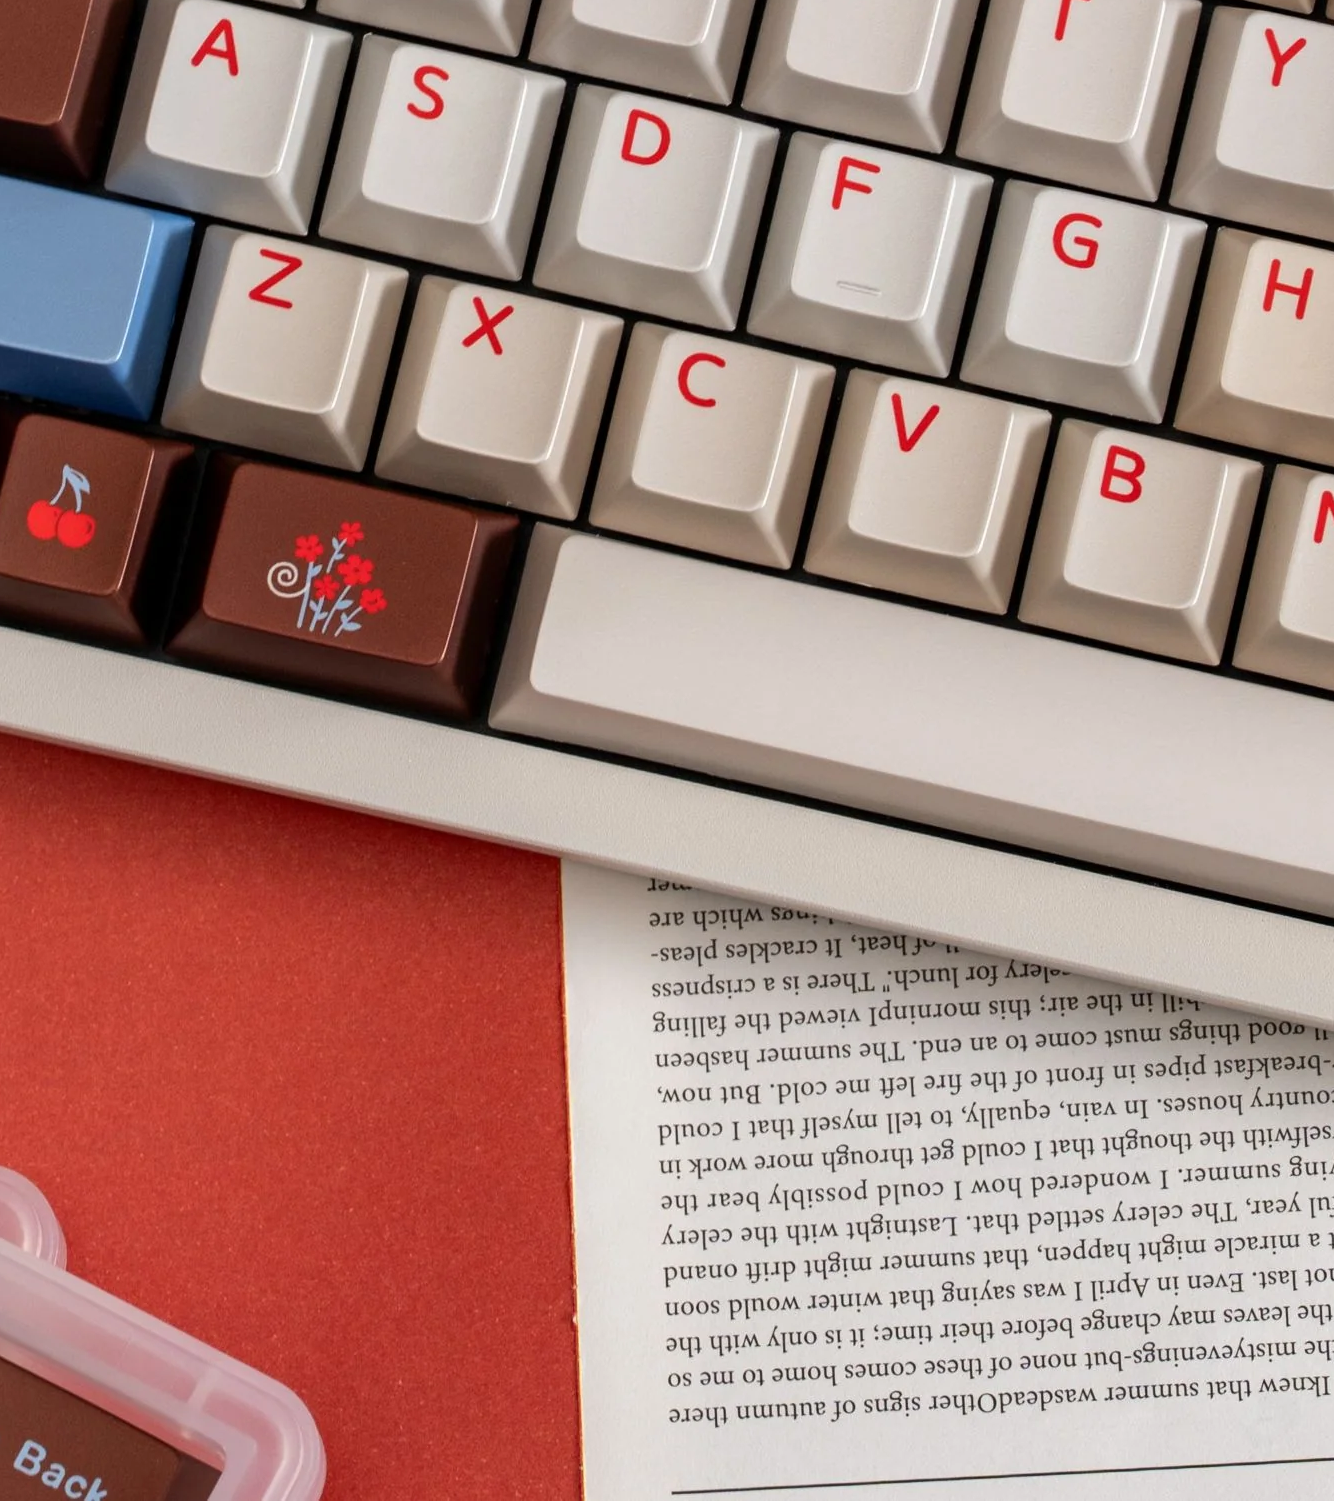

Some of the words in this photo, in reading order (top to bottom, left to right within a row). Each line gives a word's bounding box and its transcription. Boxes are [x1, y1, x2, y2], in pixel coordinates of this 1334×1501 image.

[191, 19, 239, 76] A
[1265, 28, 1306, 87] Y
[407, 65, 449, 120] S
[621, 109, 671, 165] D
[831, 156, 881, 209] F
[1052, 213, 1102, 269] G
[248, 249, 303, 310] Z
[1263, 259, 1314, 320] H
[462, 297, 514, 355] X
[678, 352, 725, 408] C
[891, 393, 939, 452] V
[1100, 445, 1146, 503] B
[736, 1401, 825, 1420] autumn
[831, 1400, 856, 1422] of
[864, 1391, 920, 1417] signs
[929, 1388, 1097, 1415] wasdeadOther
[1104, 1382, 1199, 1401] summer
[1206, 1380, 1252, 1402] that
[1259, 1376, 1330, 1398] Iknew
[669, 1406, 728, 1428] there
[13, 1439, 108, 1501] Back
